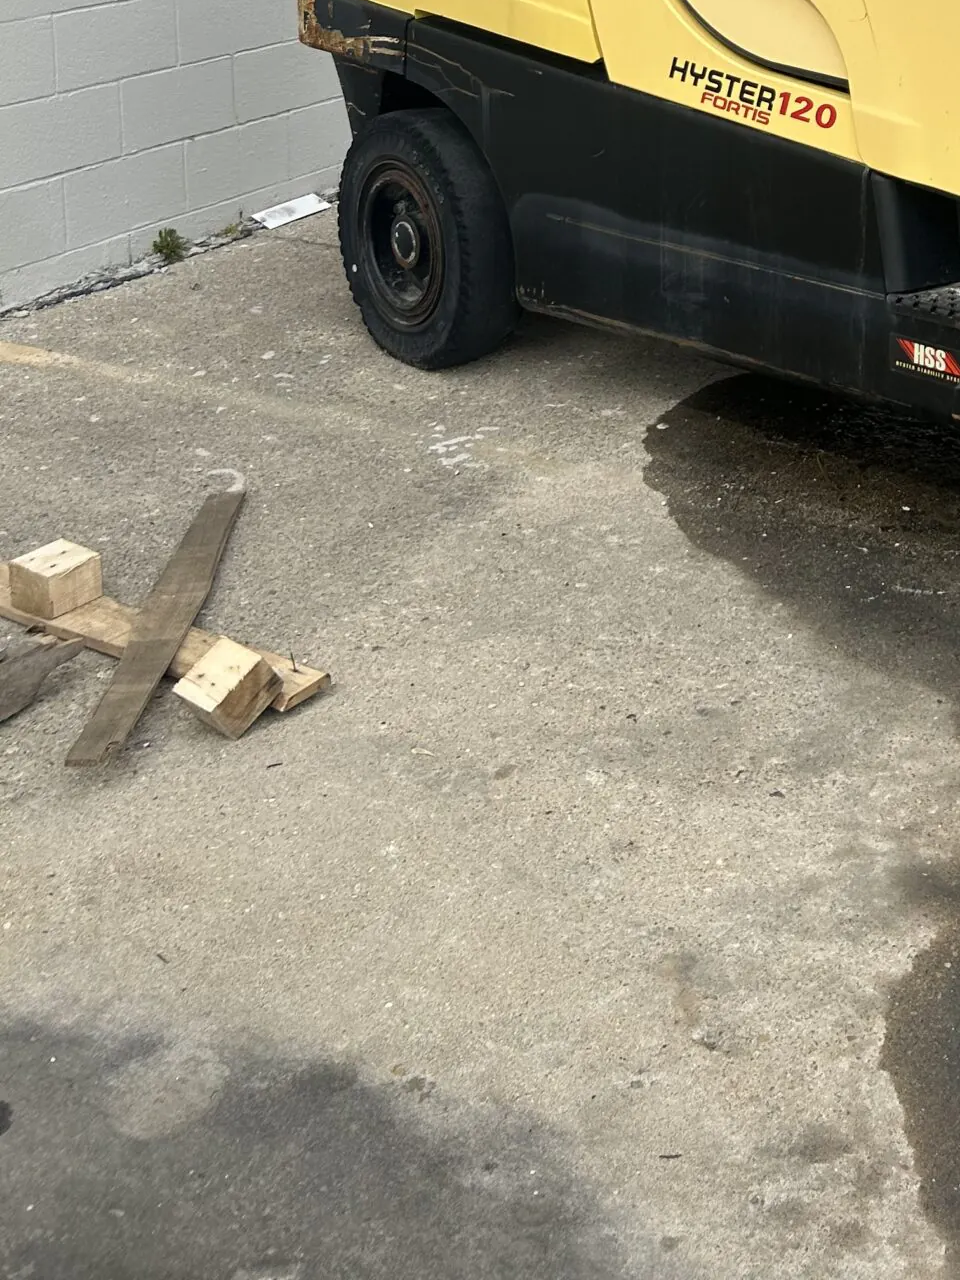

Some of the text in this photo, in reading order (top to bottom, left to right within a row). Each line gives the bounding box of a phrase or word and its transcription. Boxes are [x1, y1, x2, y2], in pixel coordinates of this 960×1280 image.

[669, 56, 837, 129] HYSTER 120
[700, 91, 771, 126] FORTIS
[913, 342, 947, 372] HSS
